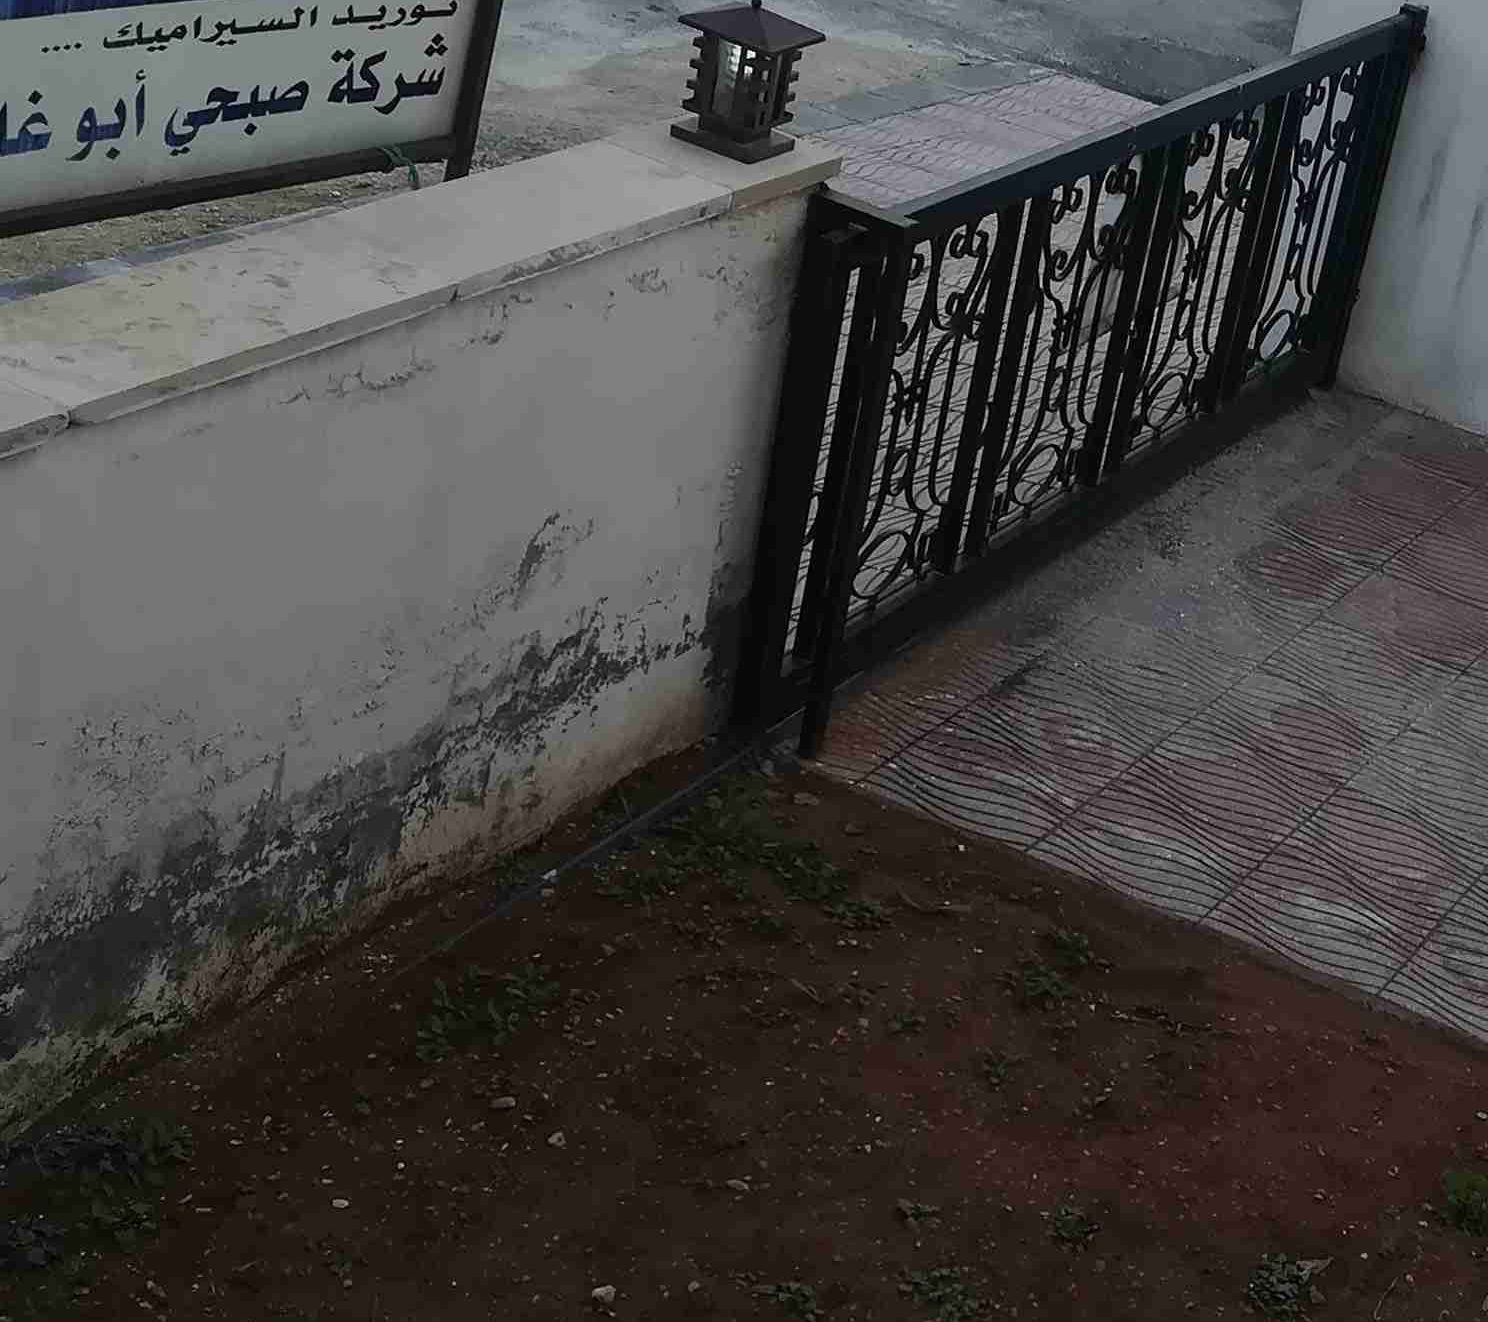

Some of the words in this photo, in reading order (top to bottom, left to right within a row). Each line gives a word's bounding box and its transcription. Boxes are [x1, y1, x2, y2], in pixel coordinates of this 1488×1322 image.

[102, 6, 318, 52] السيراميك
[327, 33, 449, 115] شركة
[65, 69, 146, 161] أبو
[164, 79, 309, 157] صبحي
